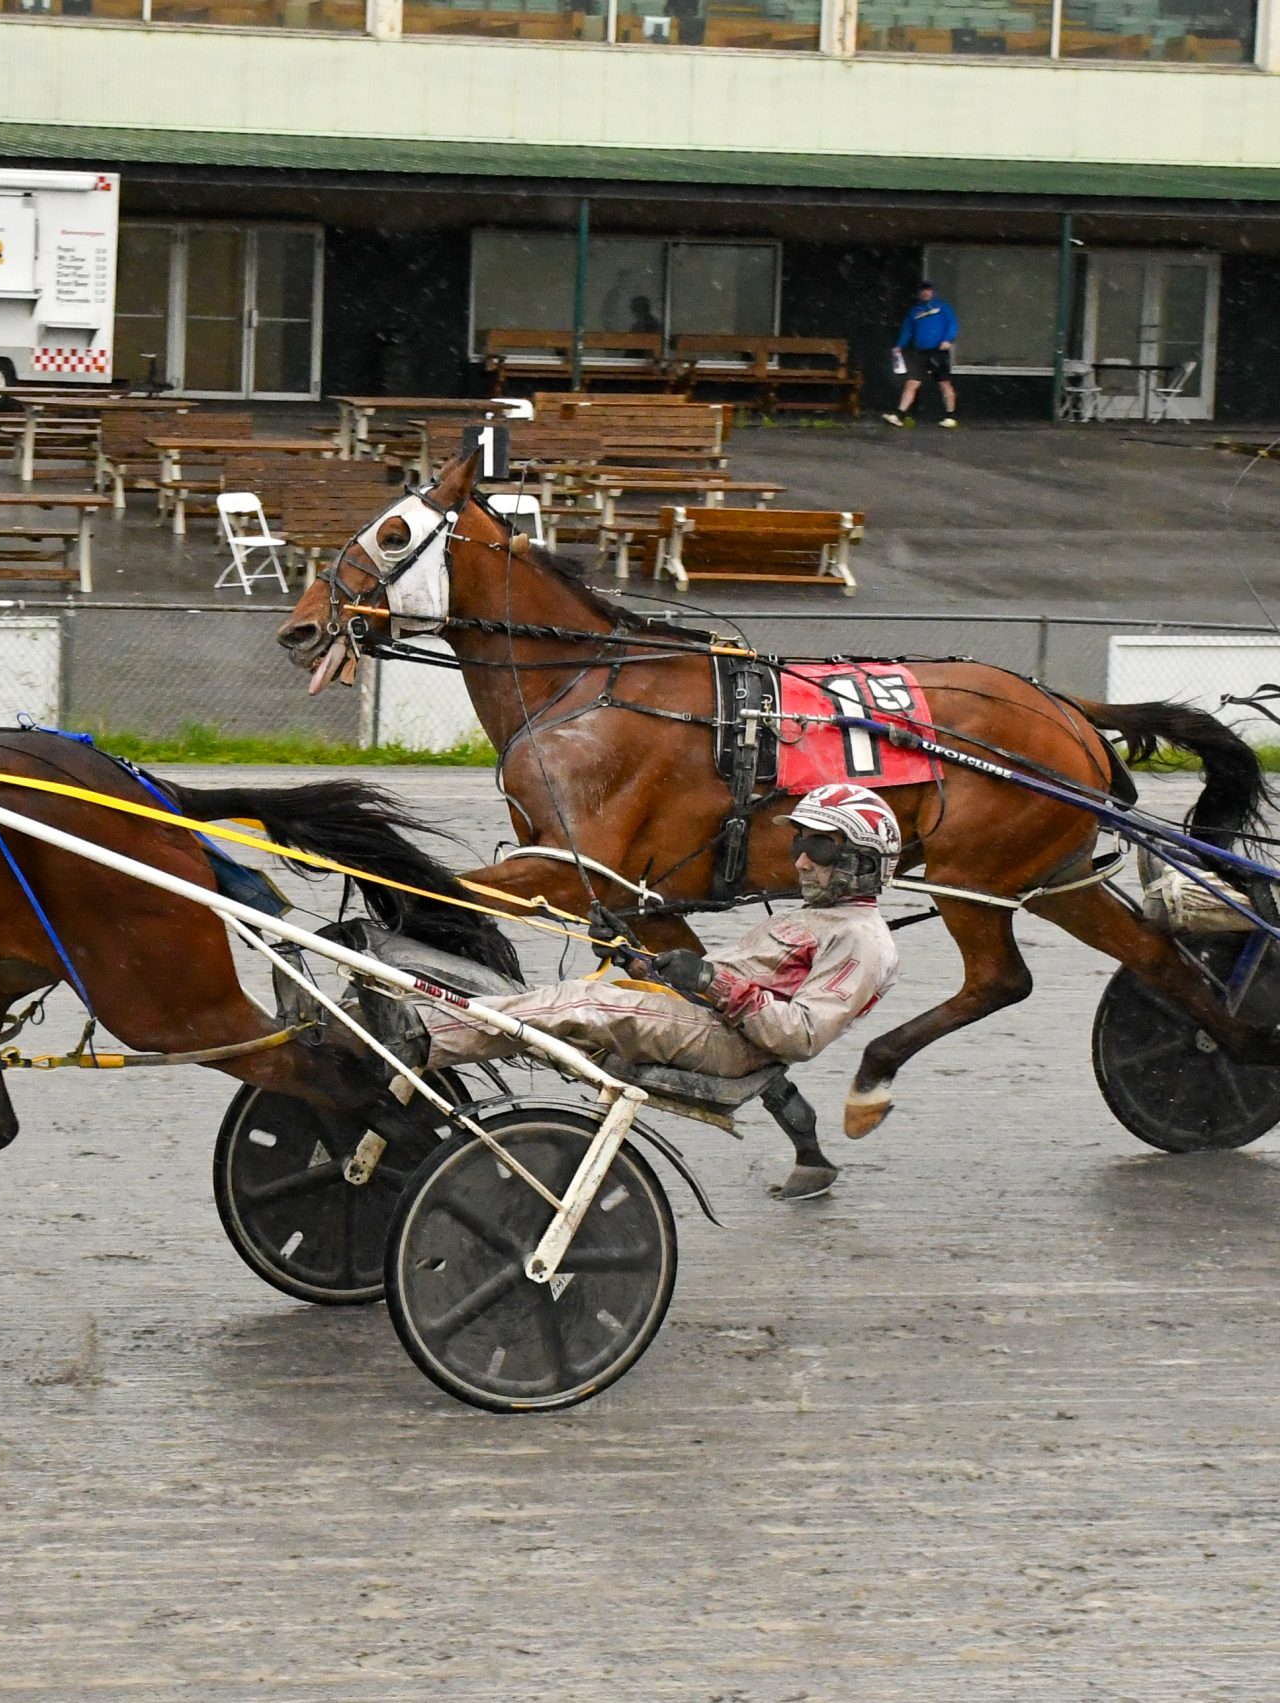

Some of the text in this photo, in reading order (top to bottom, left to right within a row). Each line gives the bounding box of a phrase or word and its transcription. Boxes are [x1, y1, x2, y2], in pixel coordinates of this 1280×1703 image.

[478, 427, 494, 477] 1
[866, 676, 913, 711] 5
[826, 678, 877, 773] 1
[820, 958, 861, 1001] L
